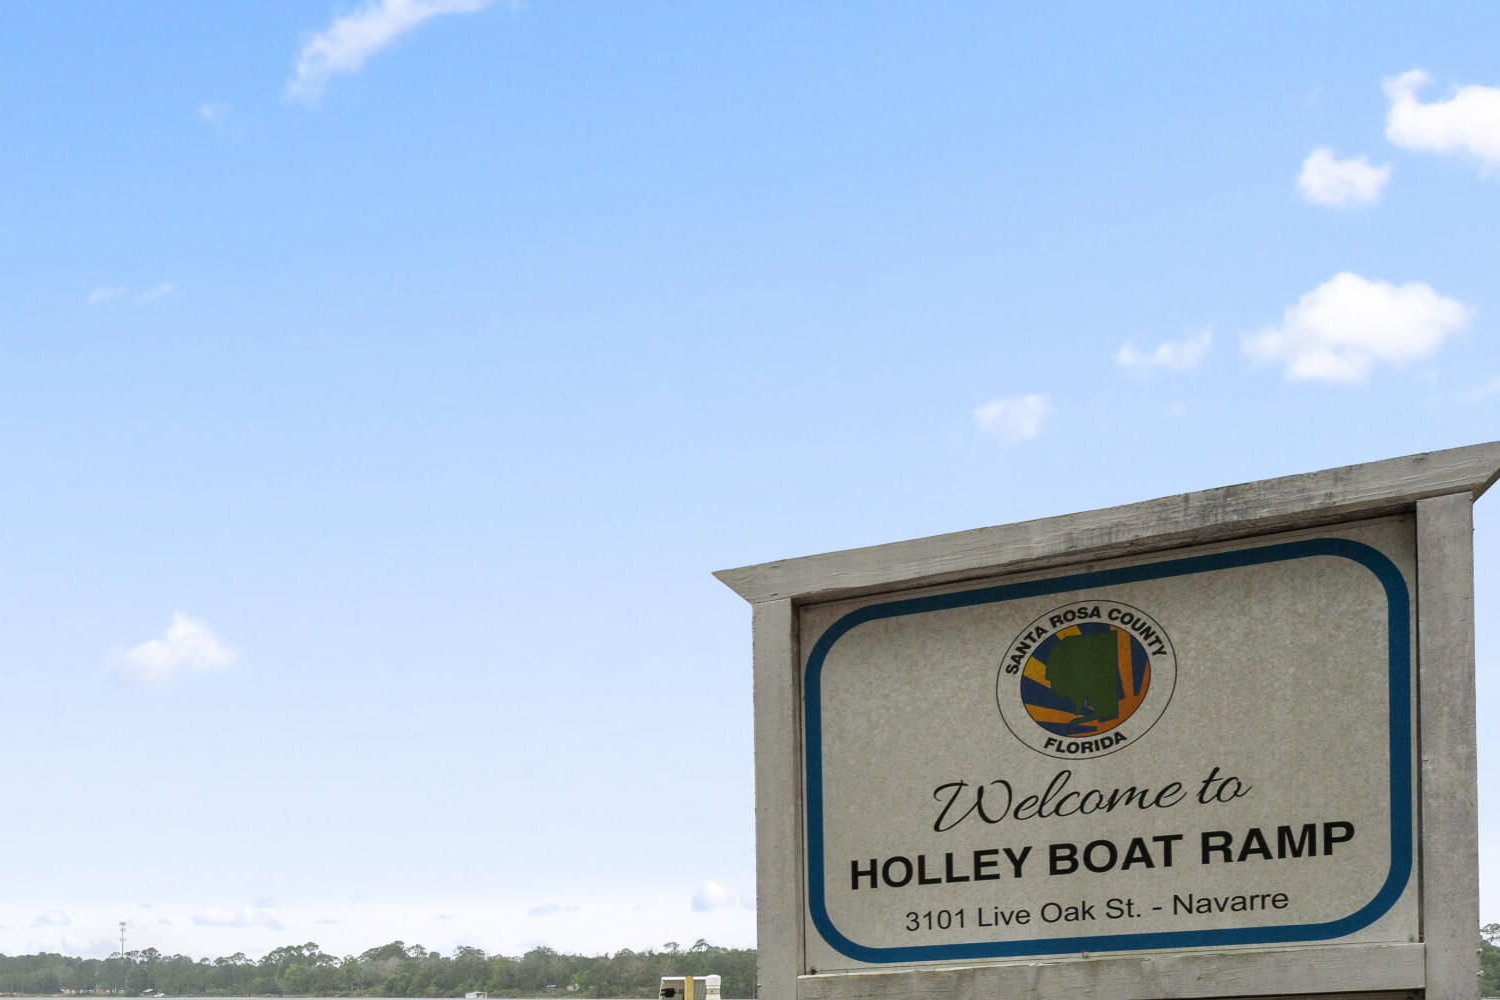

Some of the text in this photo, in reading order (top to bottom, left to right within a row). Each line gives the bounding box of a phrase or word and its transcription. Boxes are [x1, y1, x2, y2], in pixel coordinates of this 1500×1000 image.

[1005, 606, 1167, 675] SANTA ROSA COUNTY
[1043, 731, 1128, 754] FLORIDA
[932, 766, 1252, 832] Welcome to
[851, 821, 1355, 890] HOLLEY BOAT RAMP
[905, 908, 965, 931] 3101
[978, 906, 1031, 927] Live
[1040, 900, 1096, 923] Oak
[1105, 898, 1141, 919] St.
[1173, 892, 1289, 915] Navarre
